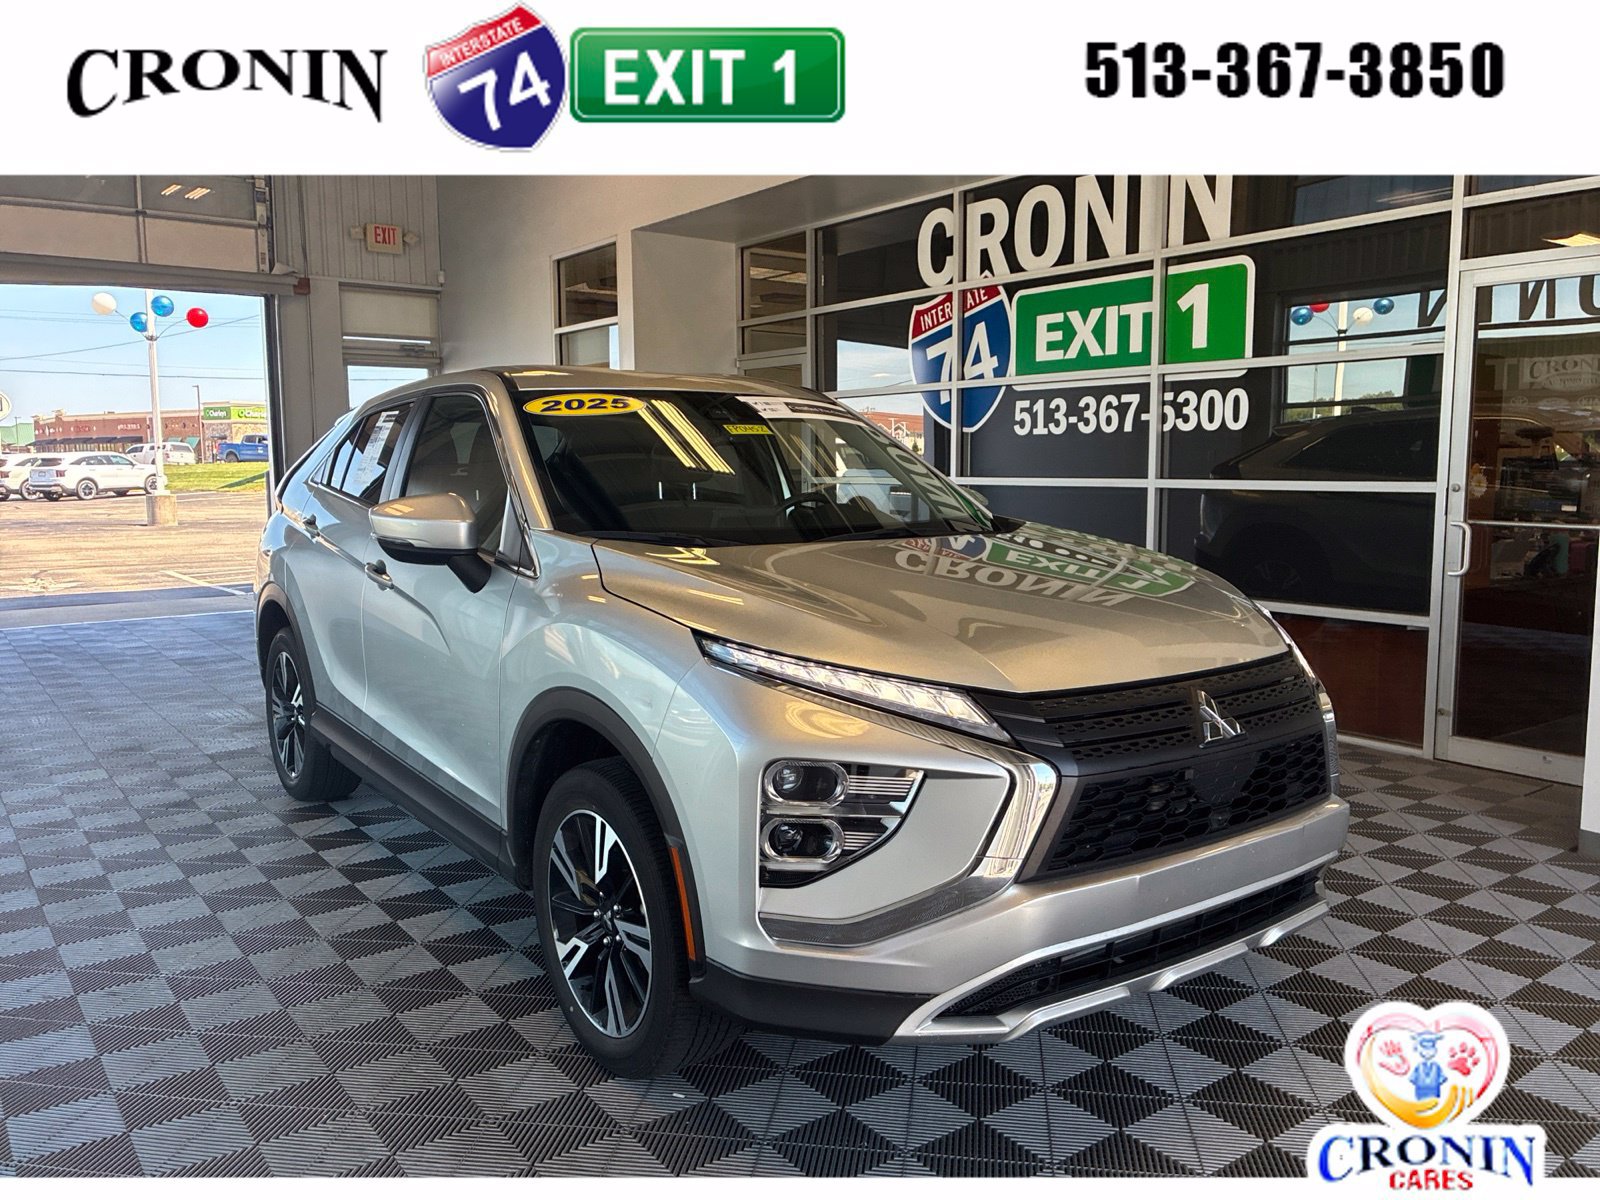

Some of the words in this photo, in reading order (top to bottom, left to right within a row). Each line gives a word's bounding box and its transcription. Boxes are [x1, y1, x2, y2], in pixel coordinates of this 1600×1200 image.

[374, 226, 396, 245] EXIT
[917, 175, 1233, 288] CRONIN
[920, 288, 988, 331] INTERATE
[1035, 301, 1153, 362] EXIT
[1176, 283, 1209, 349] 1
[926, 321, 998, 404] 74
[539, 397, 629, 413] 2025
[1013, 388, 1249, 435] 513-367-5300
